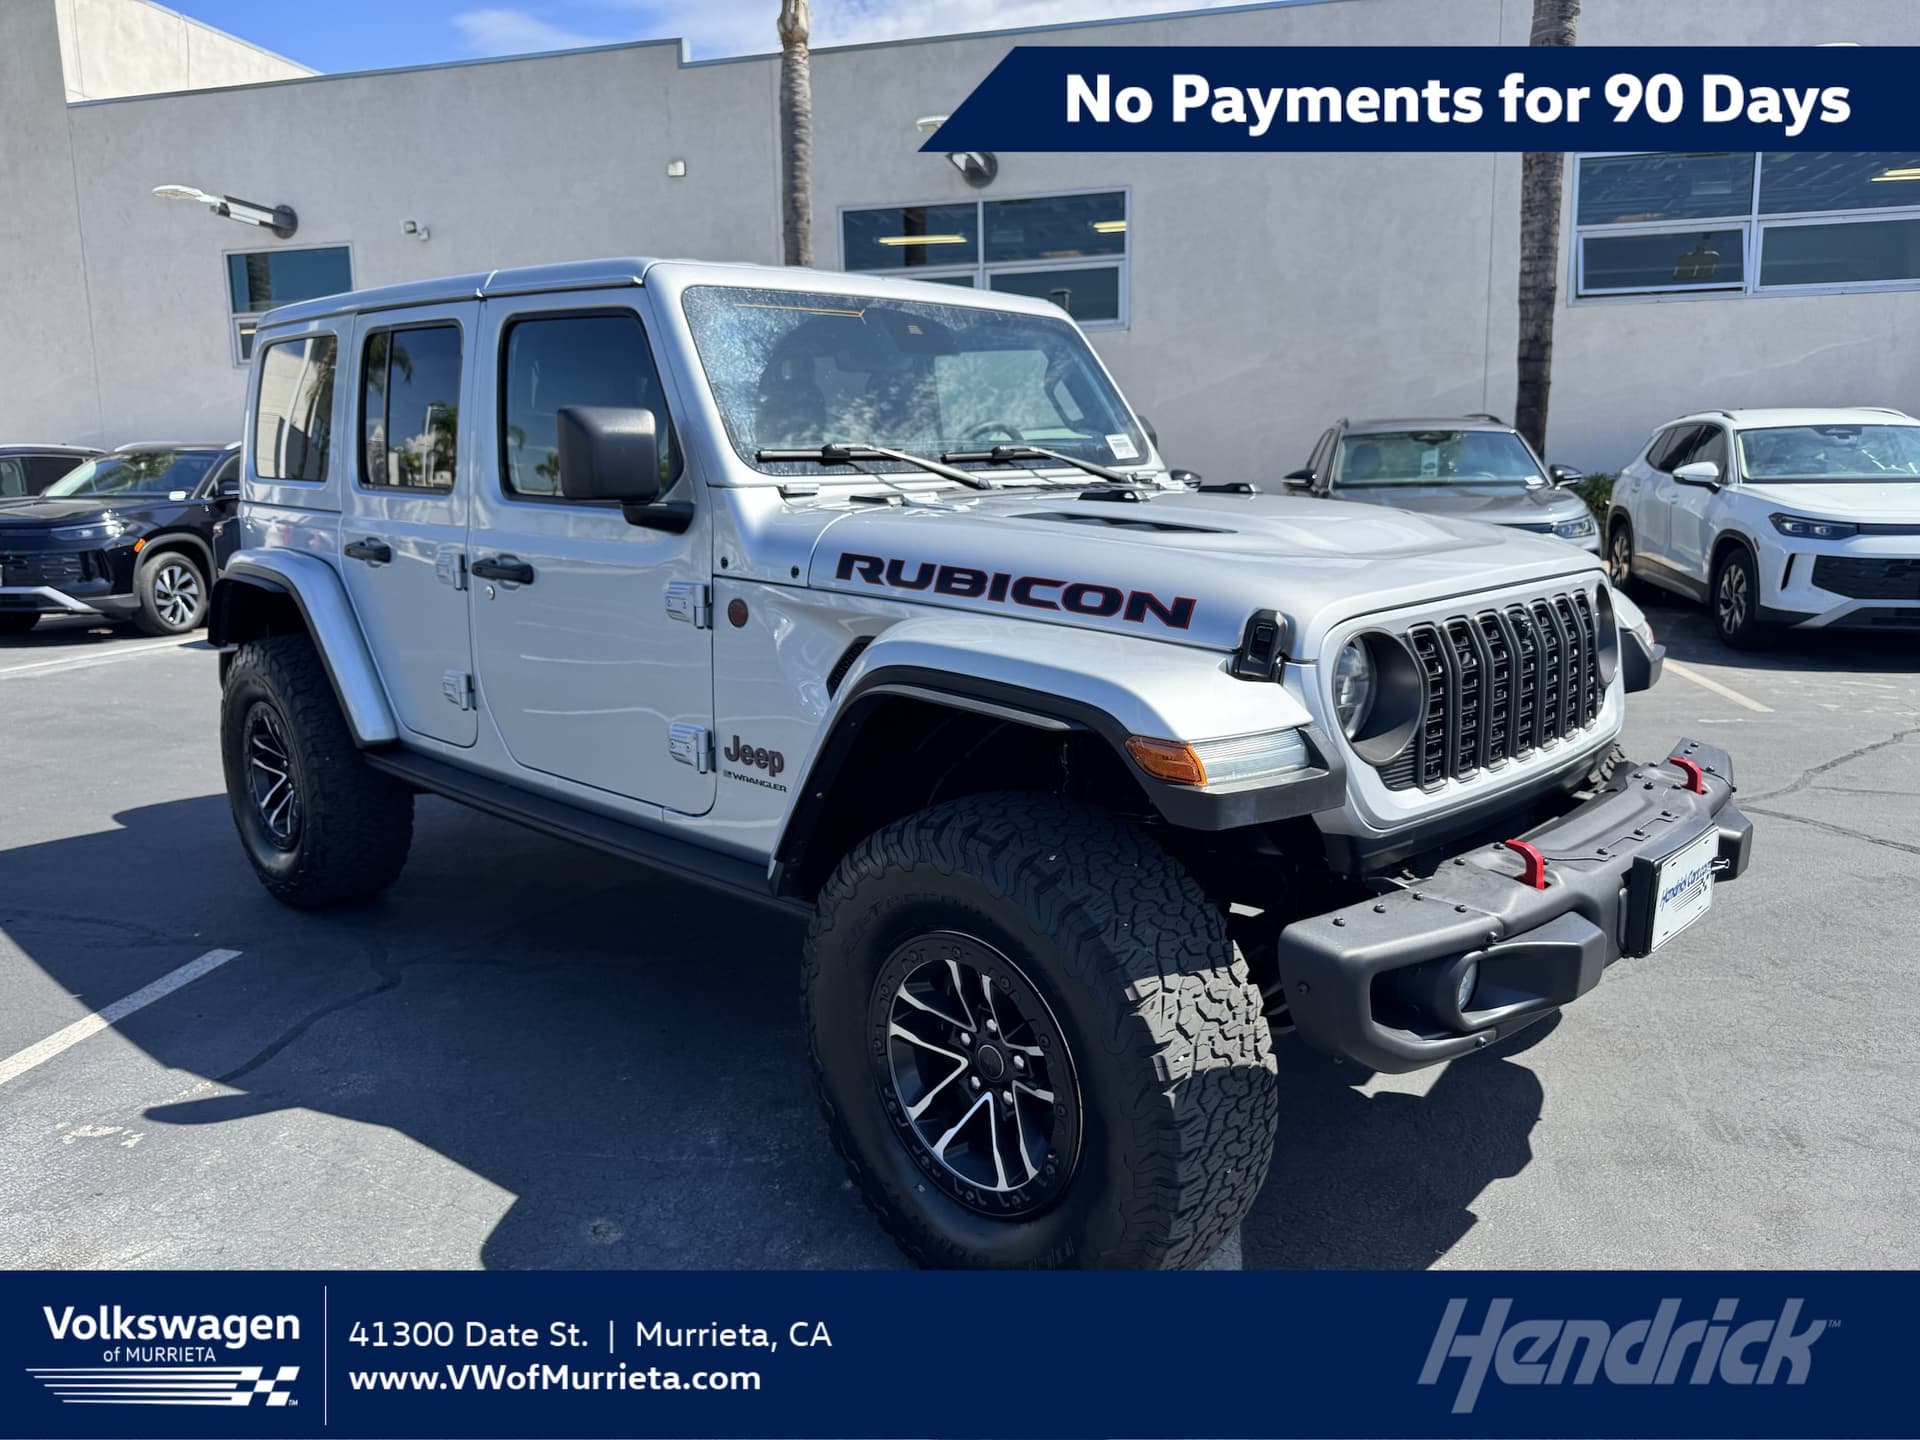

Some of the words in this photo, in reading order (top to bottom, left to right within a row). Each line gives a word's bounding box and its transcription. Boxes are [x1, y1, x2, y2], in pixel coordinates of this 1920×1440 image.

[835, 552, 1197, 630] RUBICON
[724, 735, 784, 777] Jeep
[732, 772, 787, 792] WRANGLER
